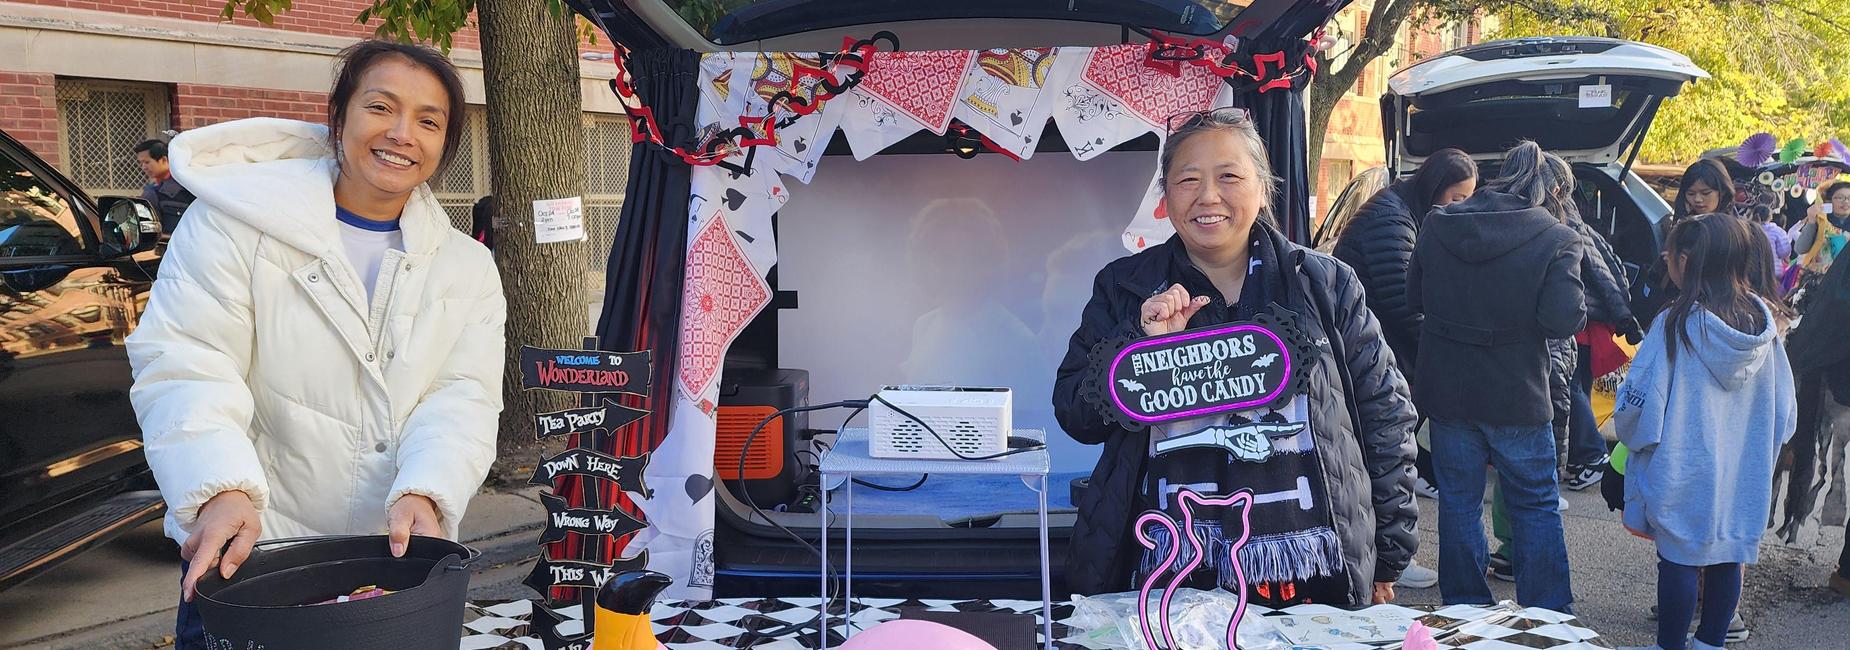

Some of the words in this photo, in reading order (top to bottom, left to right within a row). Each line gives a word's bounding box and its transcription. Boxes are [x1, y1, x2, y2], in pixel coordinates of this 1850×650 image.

[1073, 140, 1095, 157] K
[555, 355, 601, 366] WELCOME
[608, 355, 623, 366] TO
[1131, 353, 1144, 377] THE
[1141, 334, 1257, 373] NEIGHBORS
[1172, 366, 1205, 387] have
[1203, 360, 1232, 380] the
[1140, 385, 1198, 413] GOOD
[1201, 373, 1267, 403] CANDY
